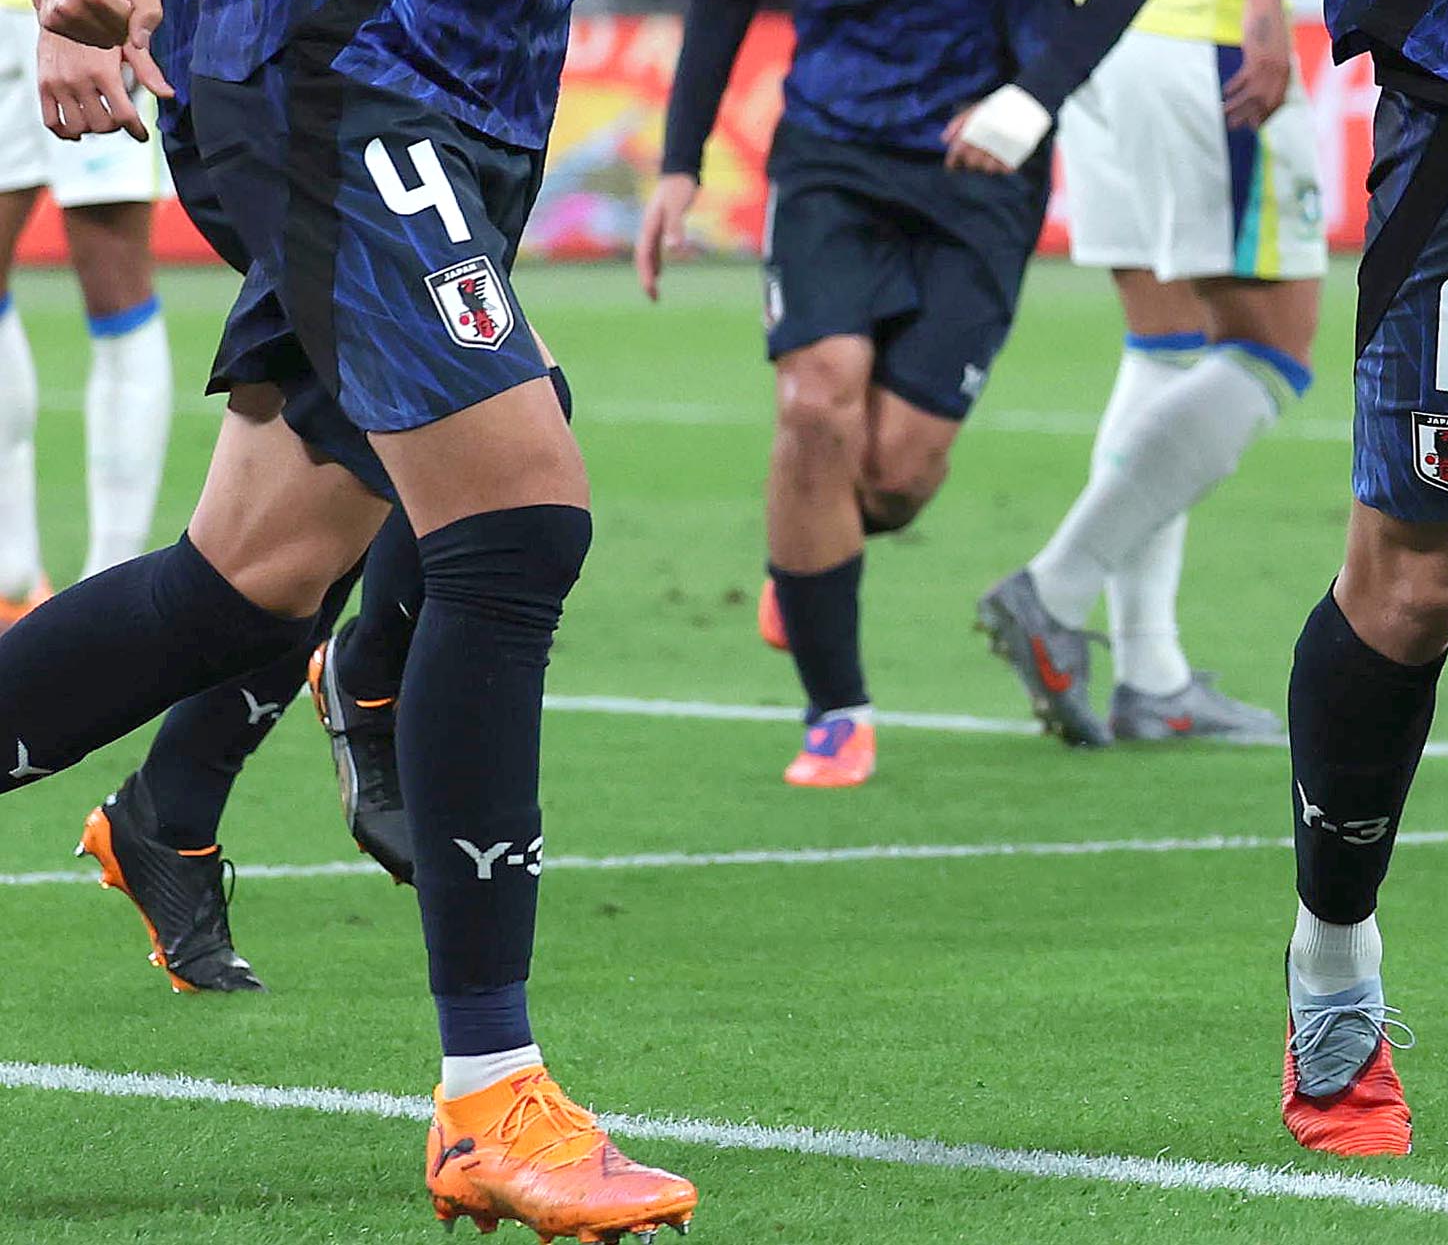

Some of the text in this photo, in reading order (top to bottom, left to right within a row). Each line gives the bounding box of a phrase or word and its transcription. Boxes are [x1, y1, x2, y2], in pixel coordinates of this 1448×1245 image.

[364, 137, 472, 244] 4
[443, 263, 478, 282] JAPAN
[1297, 779, 1390, 845] Y-3
